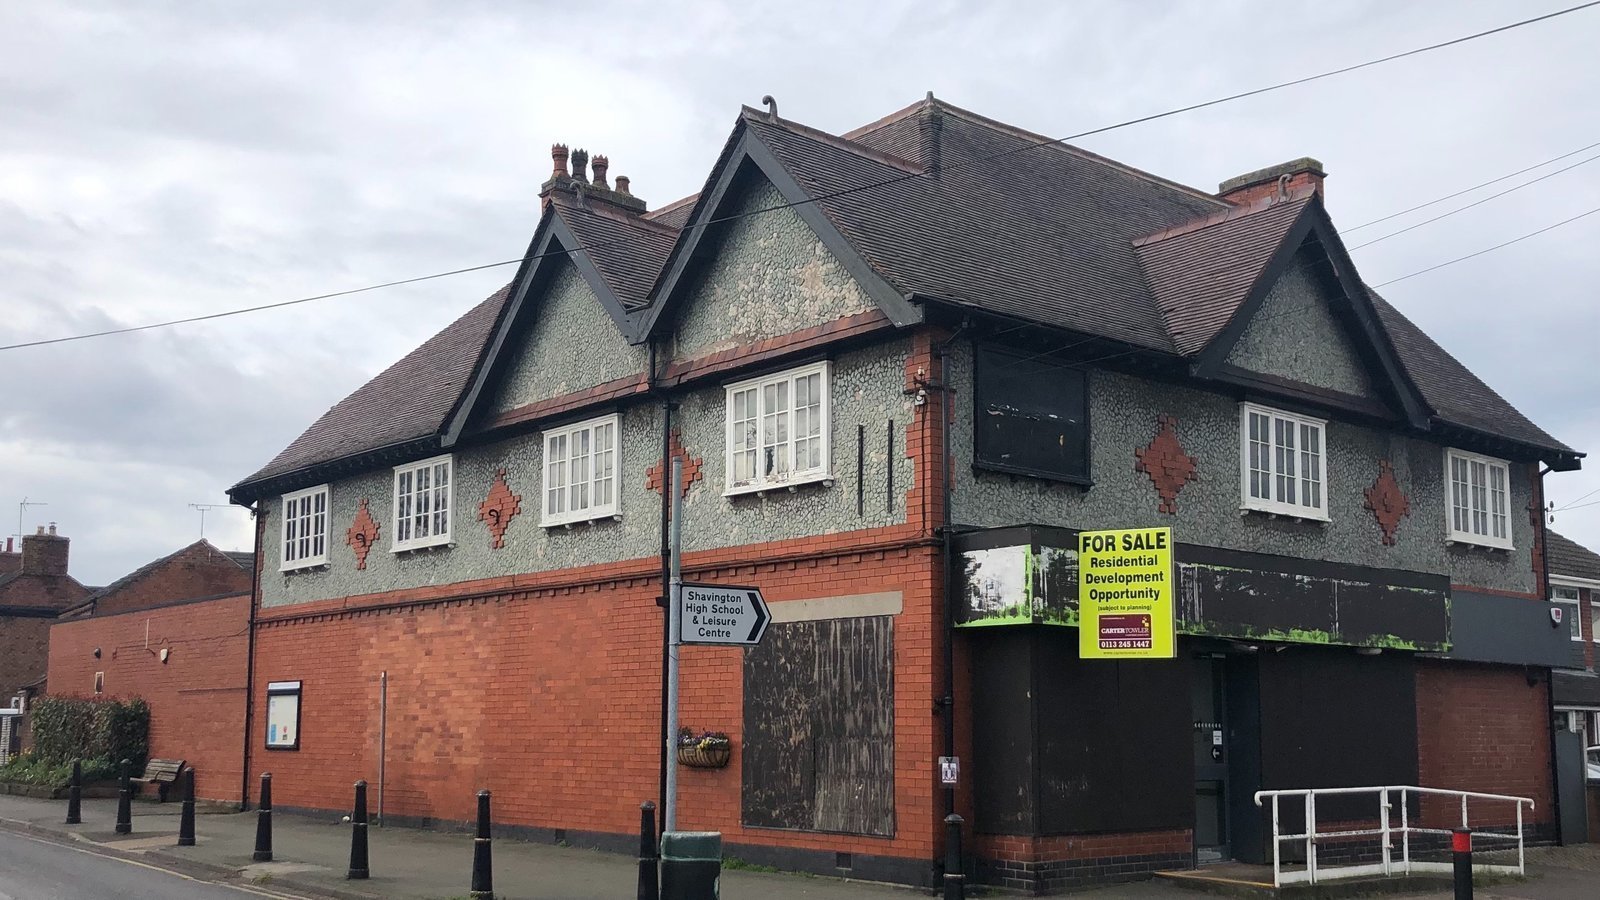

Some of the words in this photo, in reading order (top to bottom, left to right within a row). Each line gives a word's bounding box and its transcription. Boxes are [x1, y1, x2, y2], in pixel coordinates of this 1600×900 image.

[1082, 535, 1116, 553] FOR
[1122, 532, 1166, 551] SALE
[1090, 555, 1158, 568] Residential
[1085, 571, 1164, 585] Development
[688, 591, 742, 603] Shavington
[1089, 587, 1160, 602] Opportunity
[686, 603, 708, 614] High
[711, 604, 744, 615] School
[692, 615, 699, 625] &
[702, 616, 737, 626] Leisure
[698, 627, 731, 638] Centre
